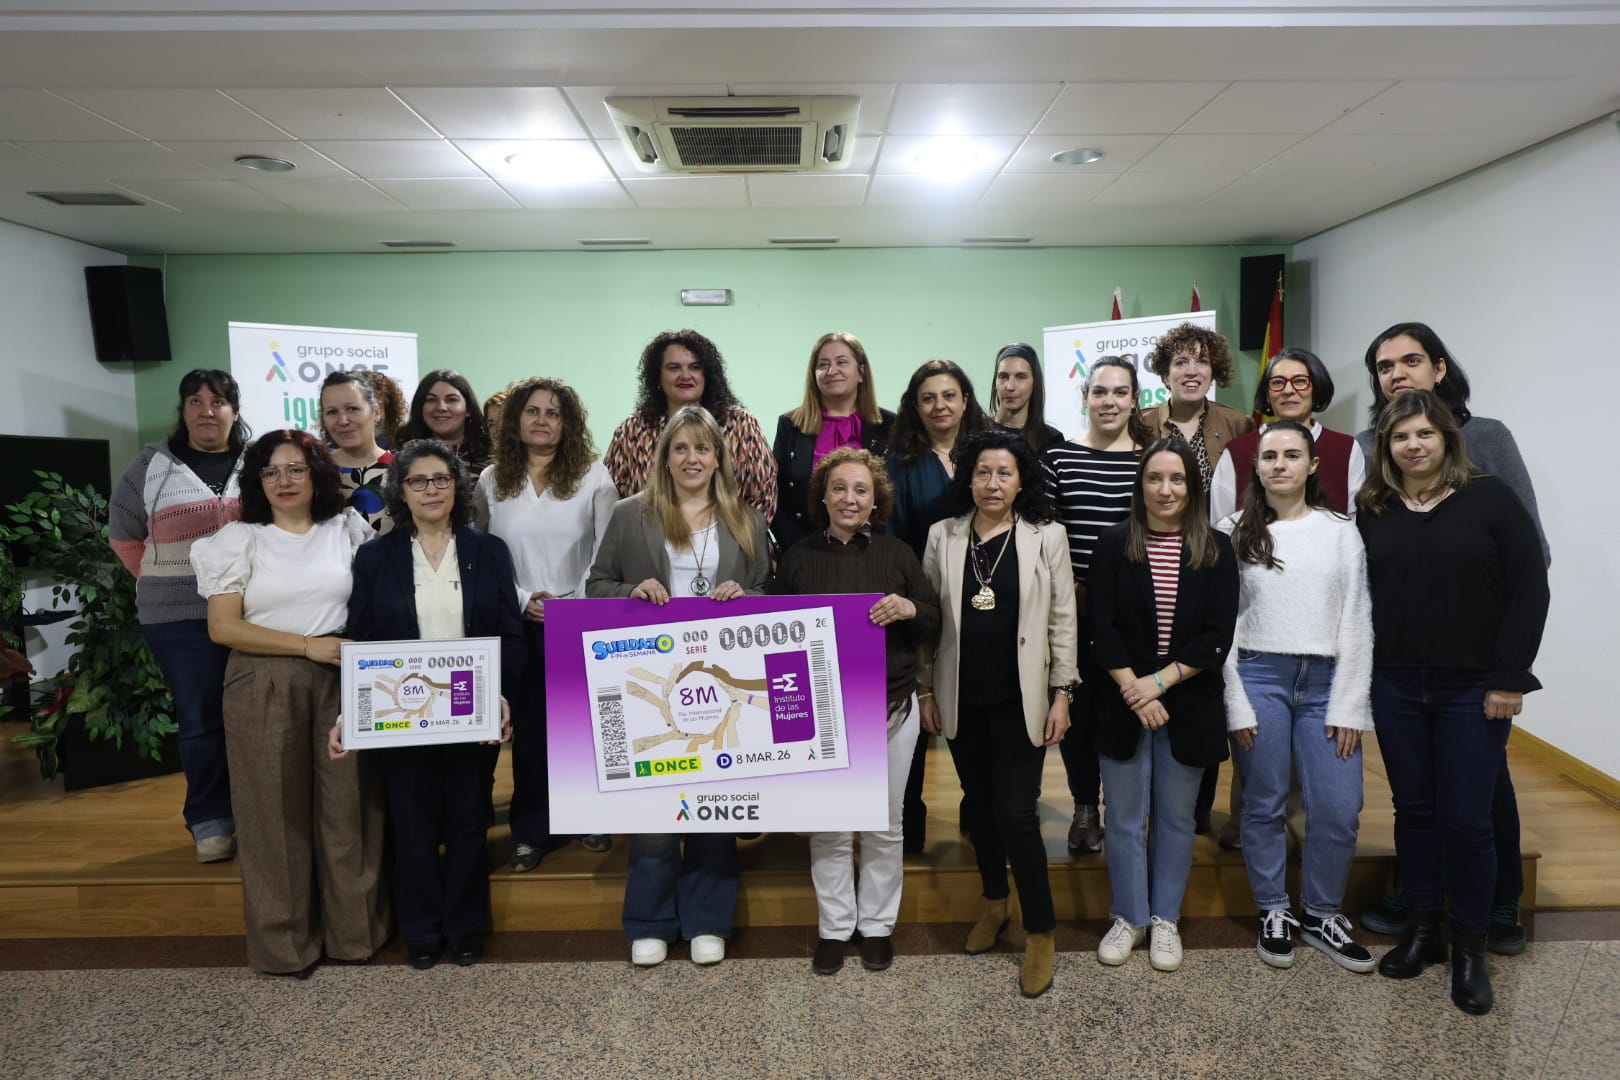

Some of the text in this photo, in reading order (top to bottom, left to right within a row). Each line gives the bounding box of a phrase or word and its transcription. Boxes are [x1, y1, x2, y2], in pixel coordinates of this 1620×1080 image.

[1096, 338, 1138, 353] grupo
[297, 345, 388, 359] grupo social
[815, 618, 828, 628] 2€
[683, 629, 709, 643] 000
[719, 620, 806, 650] 00000
[629, 649, 656, 658] SEMANA
[685, 645, 708, 655] SERIE
[403, 685, 425, 696] 8M
[680, 685, 718, 706] 8M
[774, 694, 806, 704] Instituto
[775, 704, 786, 712] de
[776, 711, 809, 721] Mujeres
[385, 721, 410, 729] ONCE
[736, 754, 743, 764] 8
[746, 750, 775, 763] MAR.
[777, 749, 791, 761] 26
[654, 758, 699, 773] ONCE
[697, 792, 760, 804] grupo social
[697, 805, 760, 821] ONCE
